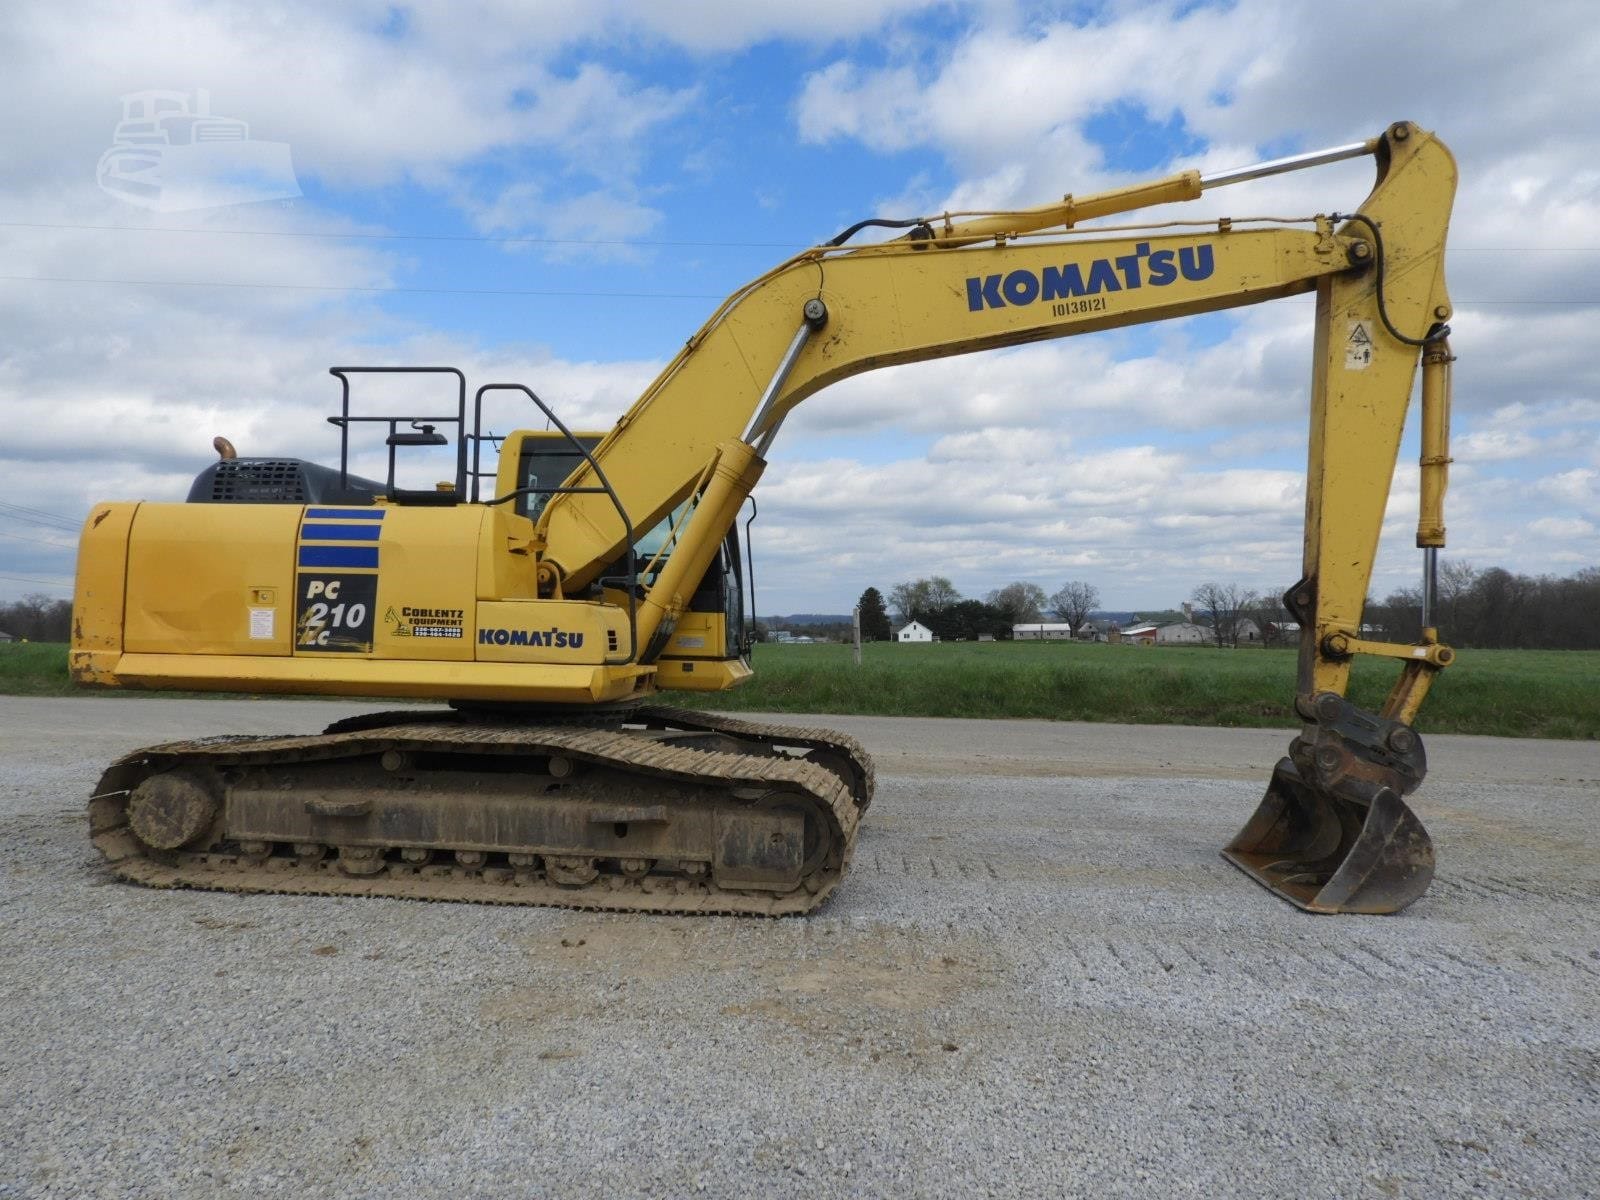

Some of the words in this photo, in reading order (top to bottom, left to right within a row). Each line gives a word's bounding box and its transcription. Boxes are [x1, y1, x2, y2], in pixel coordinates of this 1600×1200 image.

[966, 242, 1215, 312] KOMATSU
[1052, 298, 1107, 317] 10138121
[306, 580, 341, 600] PC
[305, 602, 366, 628] 210
[402, 606, 464, 618] COBLENTZ
[408, 617, 463, 626] EQUIPMENT
[478, 627, 584, 649] KOMATSU
